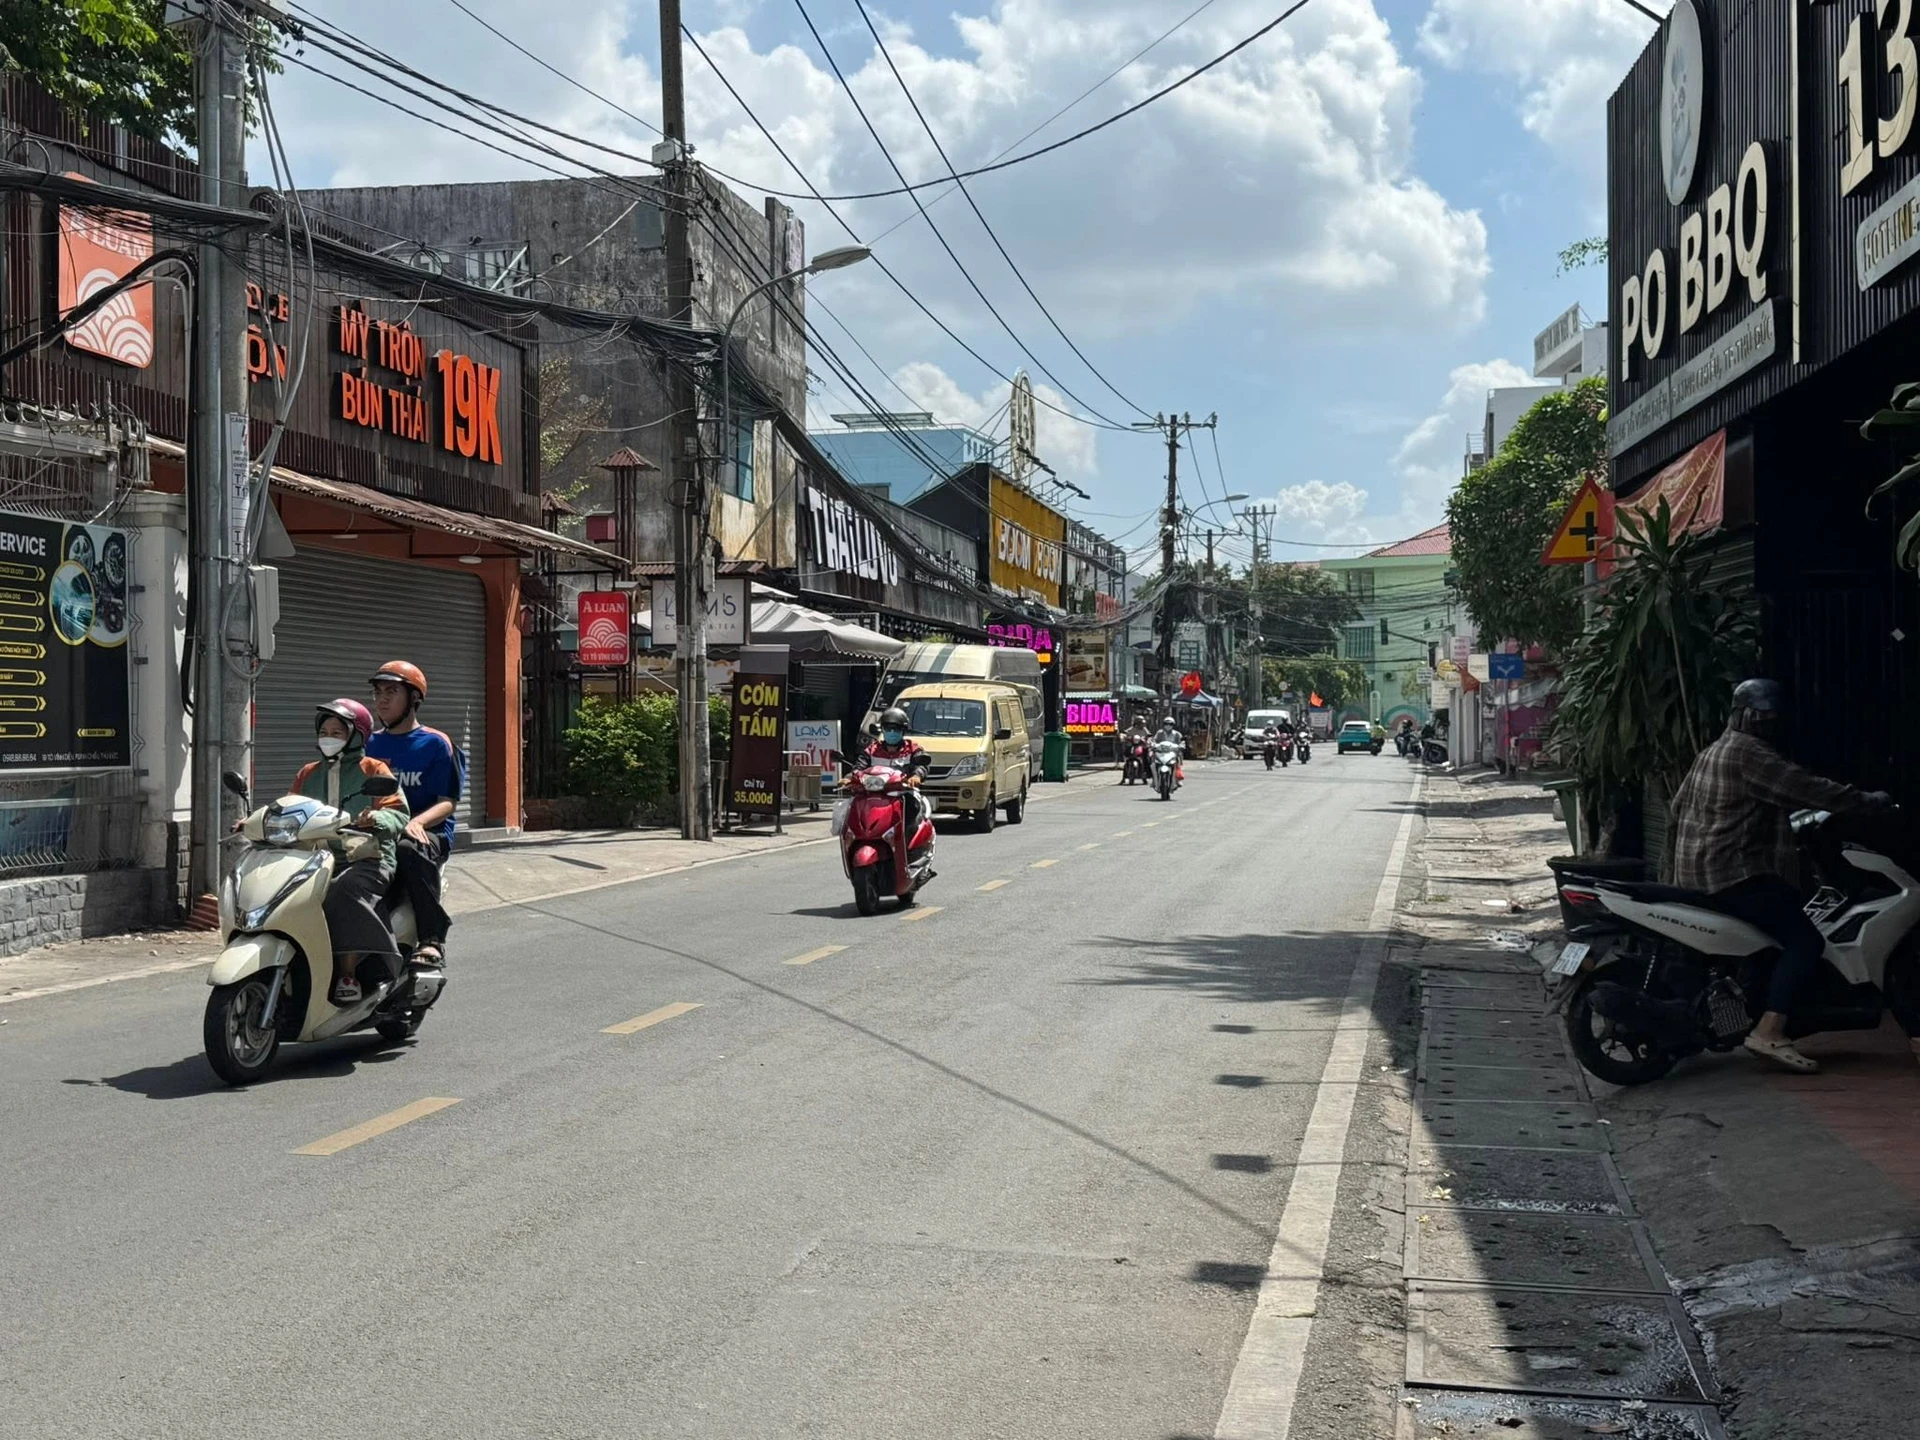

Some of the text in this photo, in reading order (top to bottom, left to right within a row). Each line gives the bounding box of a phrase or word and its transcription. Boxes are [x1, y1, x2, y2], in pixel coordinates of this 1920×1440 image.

[1622, 141, 1768, 382] PO BBQ
[376, 320, 428, 386] TRỘN
[342, 366, 431, 445] BÚN THÁI
[436, 349, 503, 466] 19K
[996, 517, 1031, 571] BOOM
[1035, 541, 1063, 586] BOOM
[582, 600, 625, 613] A LUAN
[740, 681, 780, 707] CƠM
[739, 708, 777, 737] TẤM
[1066, 703, 1114, 724] BIDA
[1066, 724, 1089, 733] BOOM
[1647, 913, 1718, 934] AIRBLADE
